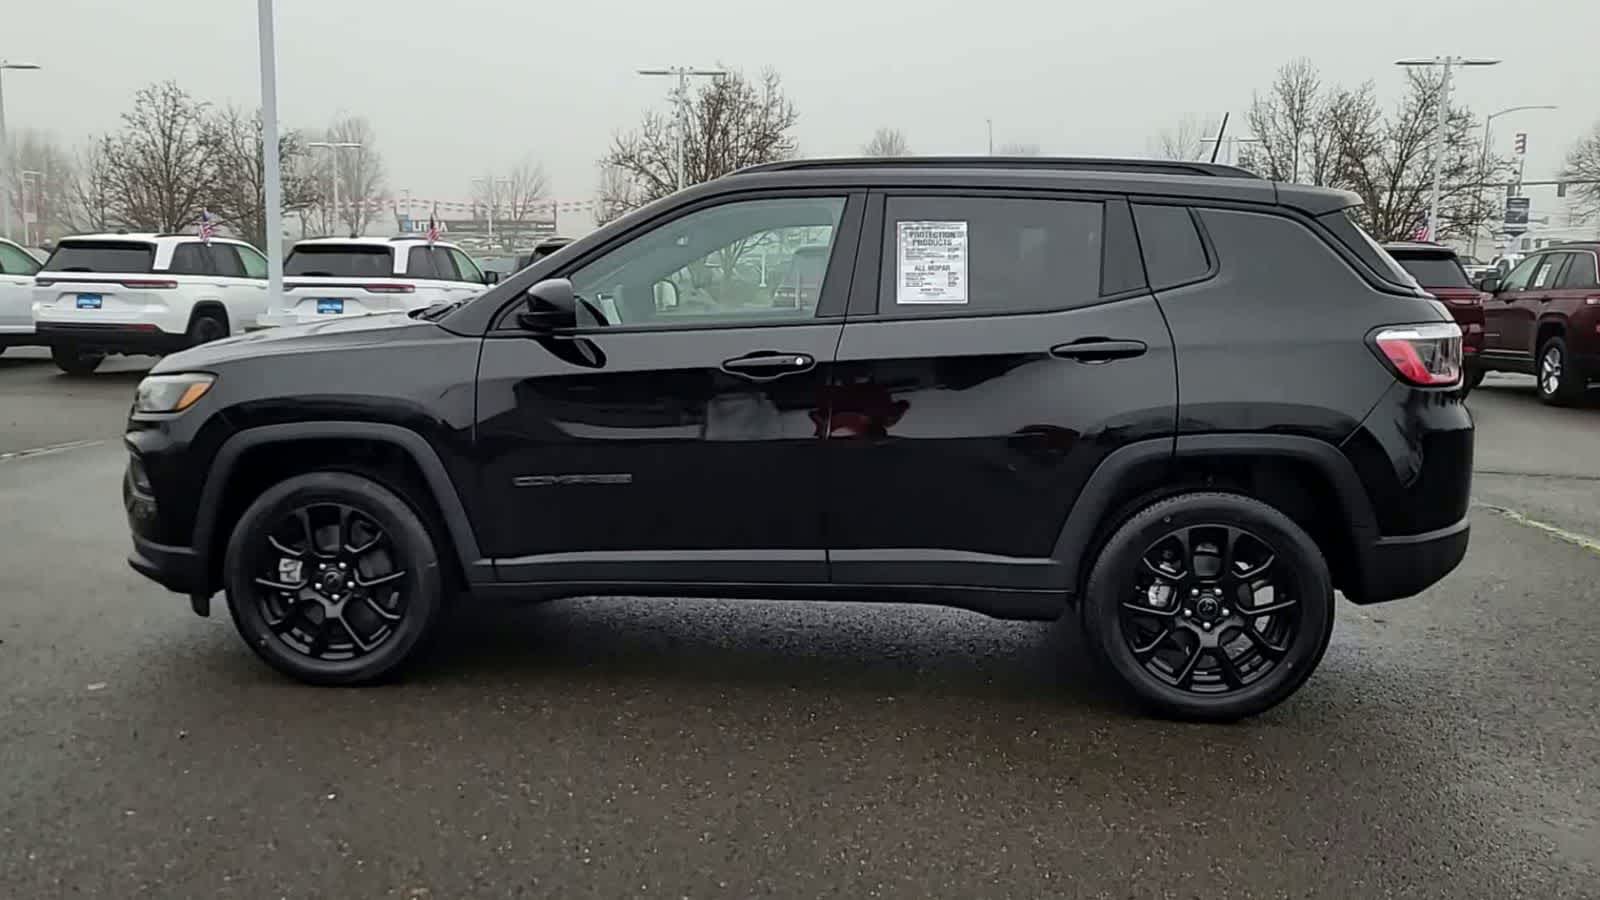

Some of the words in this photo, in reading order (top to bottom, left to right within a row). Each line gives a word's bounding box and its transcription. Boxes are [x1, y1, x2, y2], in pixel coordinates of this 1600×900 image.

[412, 221, 449, 232] LITIA
[909, 231, 956, 239] PROTECTION
[912, 239, 953, 247] PRODUCTS
[914, 264, 926, 272] ALL
[928, 264, 951, 272] MOPAR
